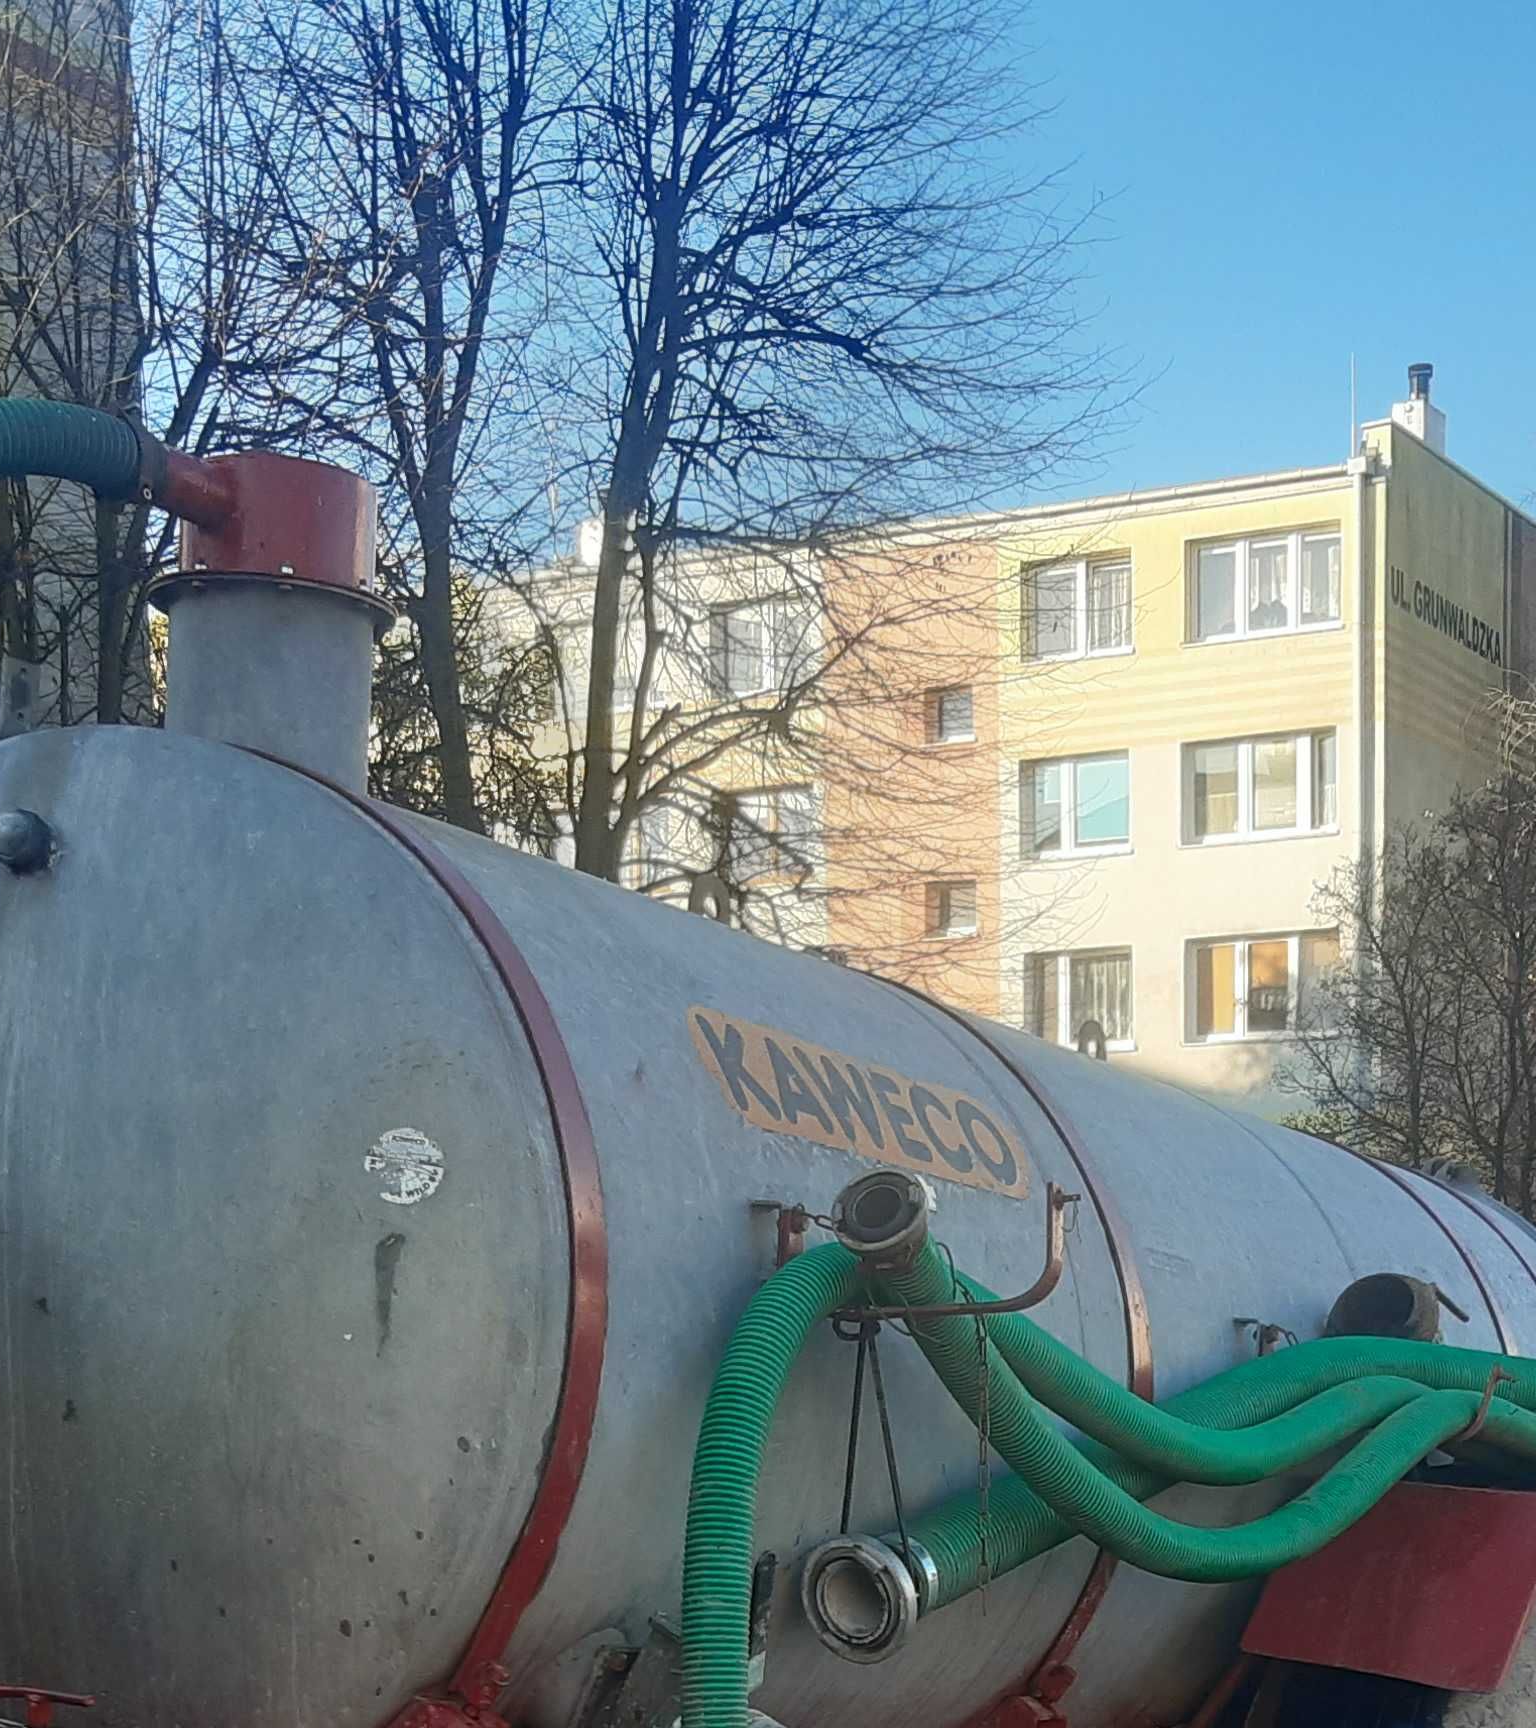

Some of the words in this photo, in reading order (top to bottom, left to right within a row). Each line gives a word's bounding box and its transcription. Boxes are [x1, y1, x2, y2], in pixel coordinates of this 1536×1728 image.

[1390, 565, 1411, 614] UL.
[1413, 579, 1502, 668] GRUNWALDZKA
[695, 1013, 1018, 1187] KAWECO
